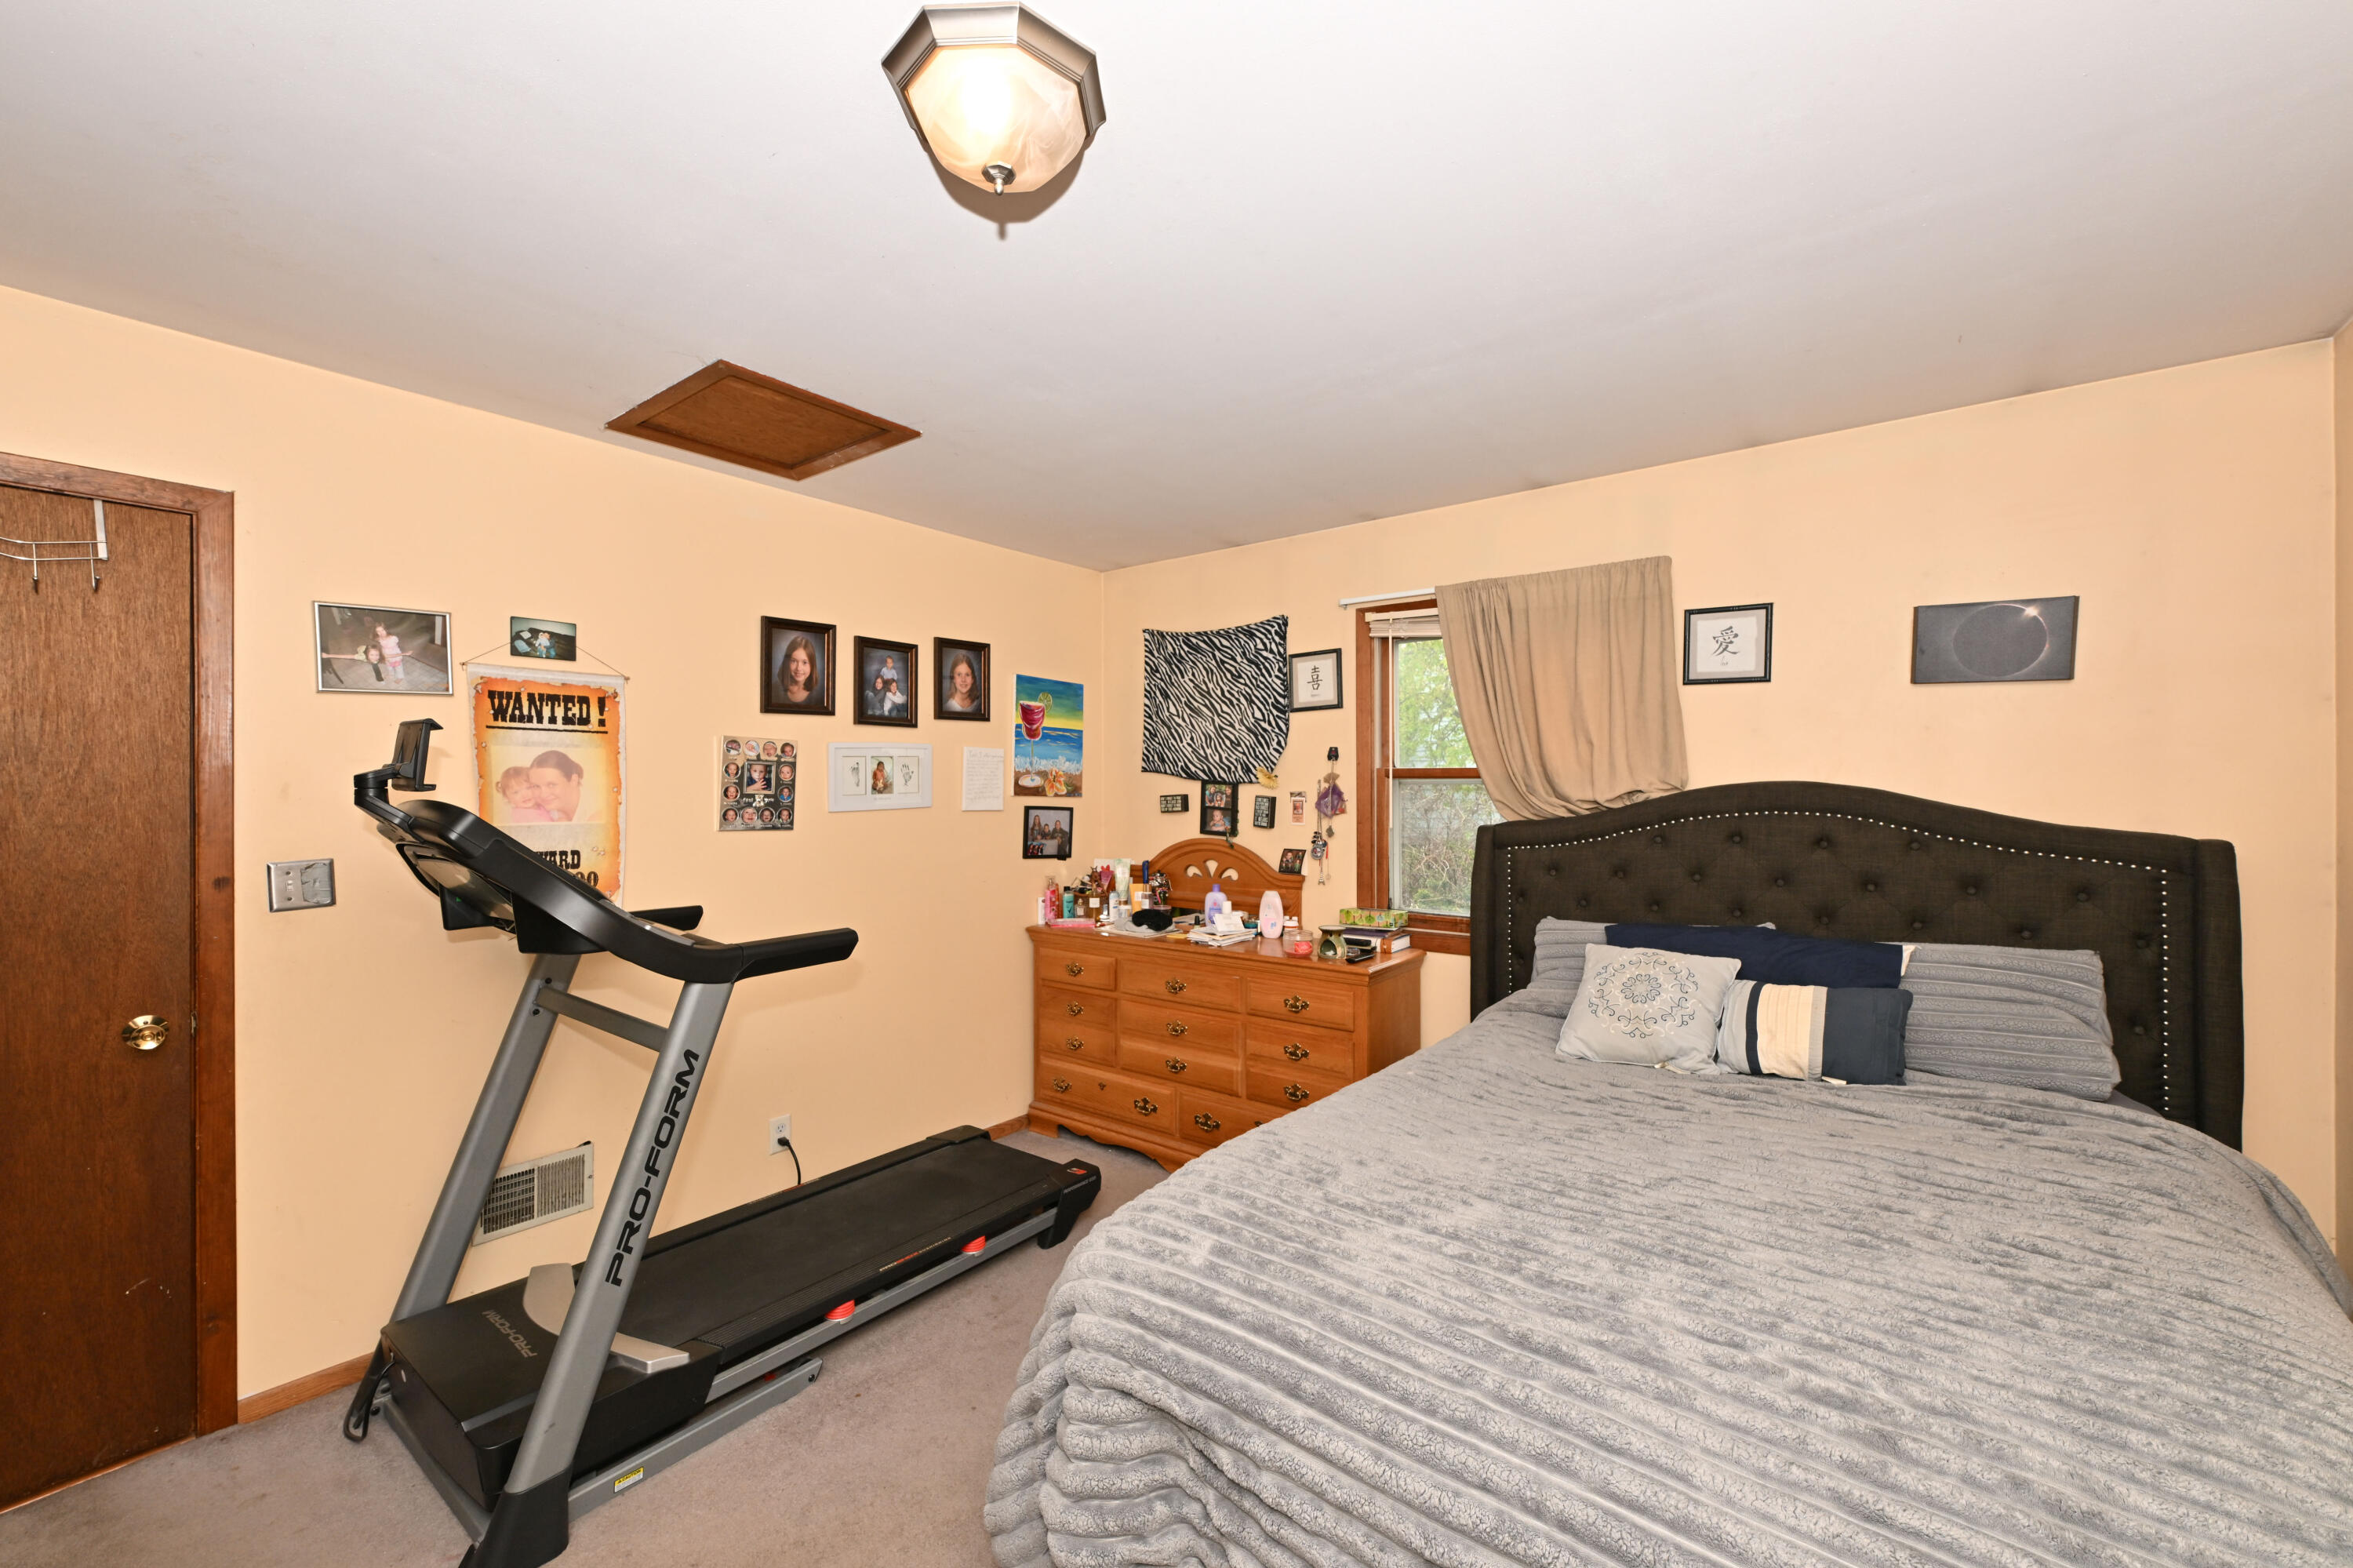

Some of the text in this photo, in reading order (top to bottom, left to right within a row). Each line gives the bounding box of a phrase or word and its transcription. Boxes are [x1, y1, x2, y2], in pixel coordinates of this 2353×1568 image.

[1711, 625, 1740, 657] 愛
[1307, 664, 1323, 690] 喜
[605, 1049, 700, 1286] PRO-FORM
[482, 1309, 538, 1358] PRO-FORM
